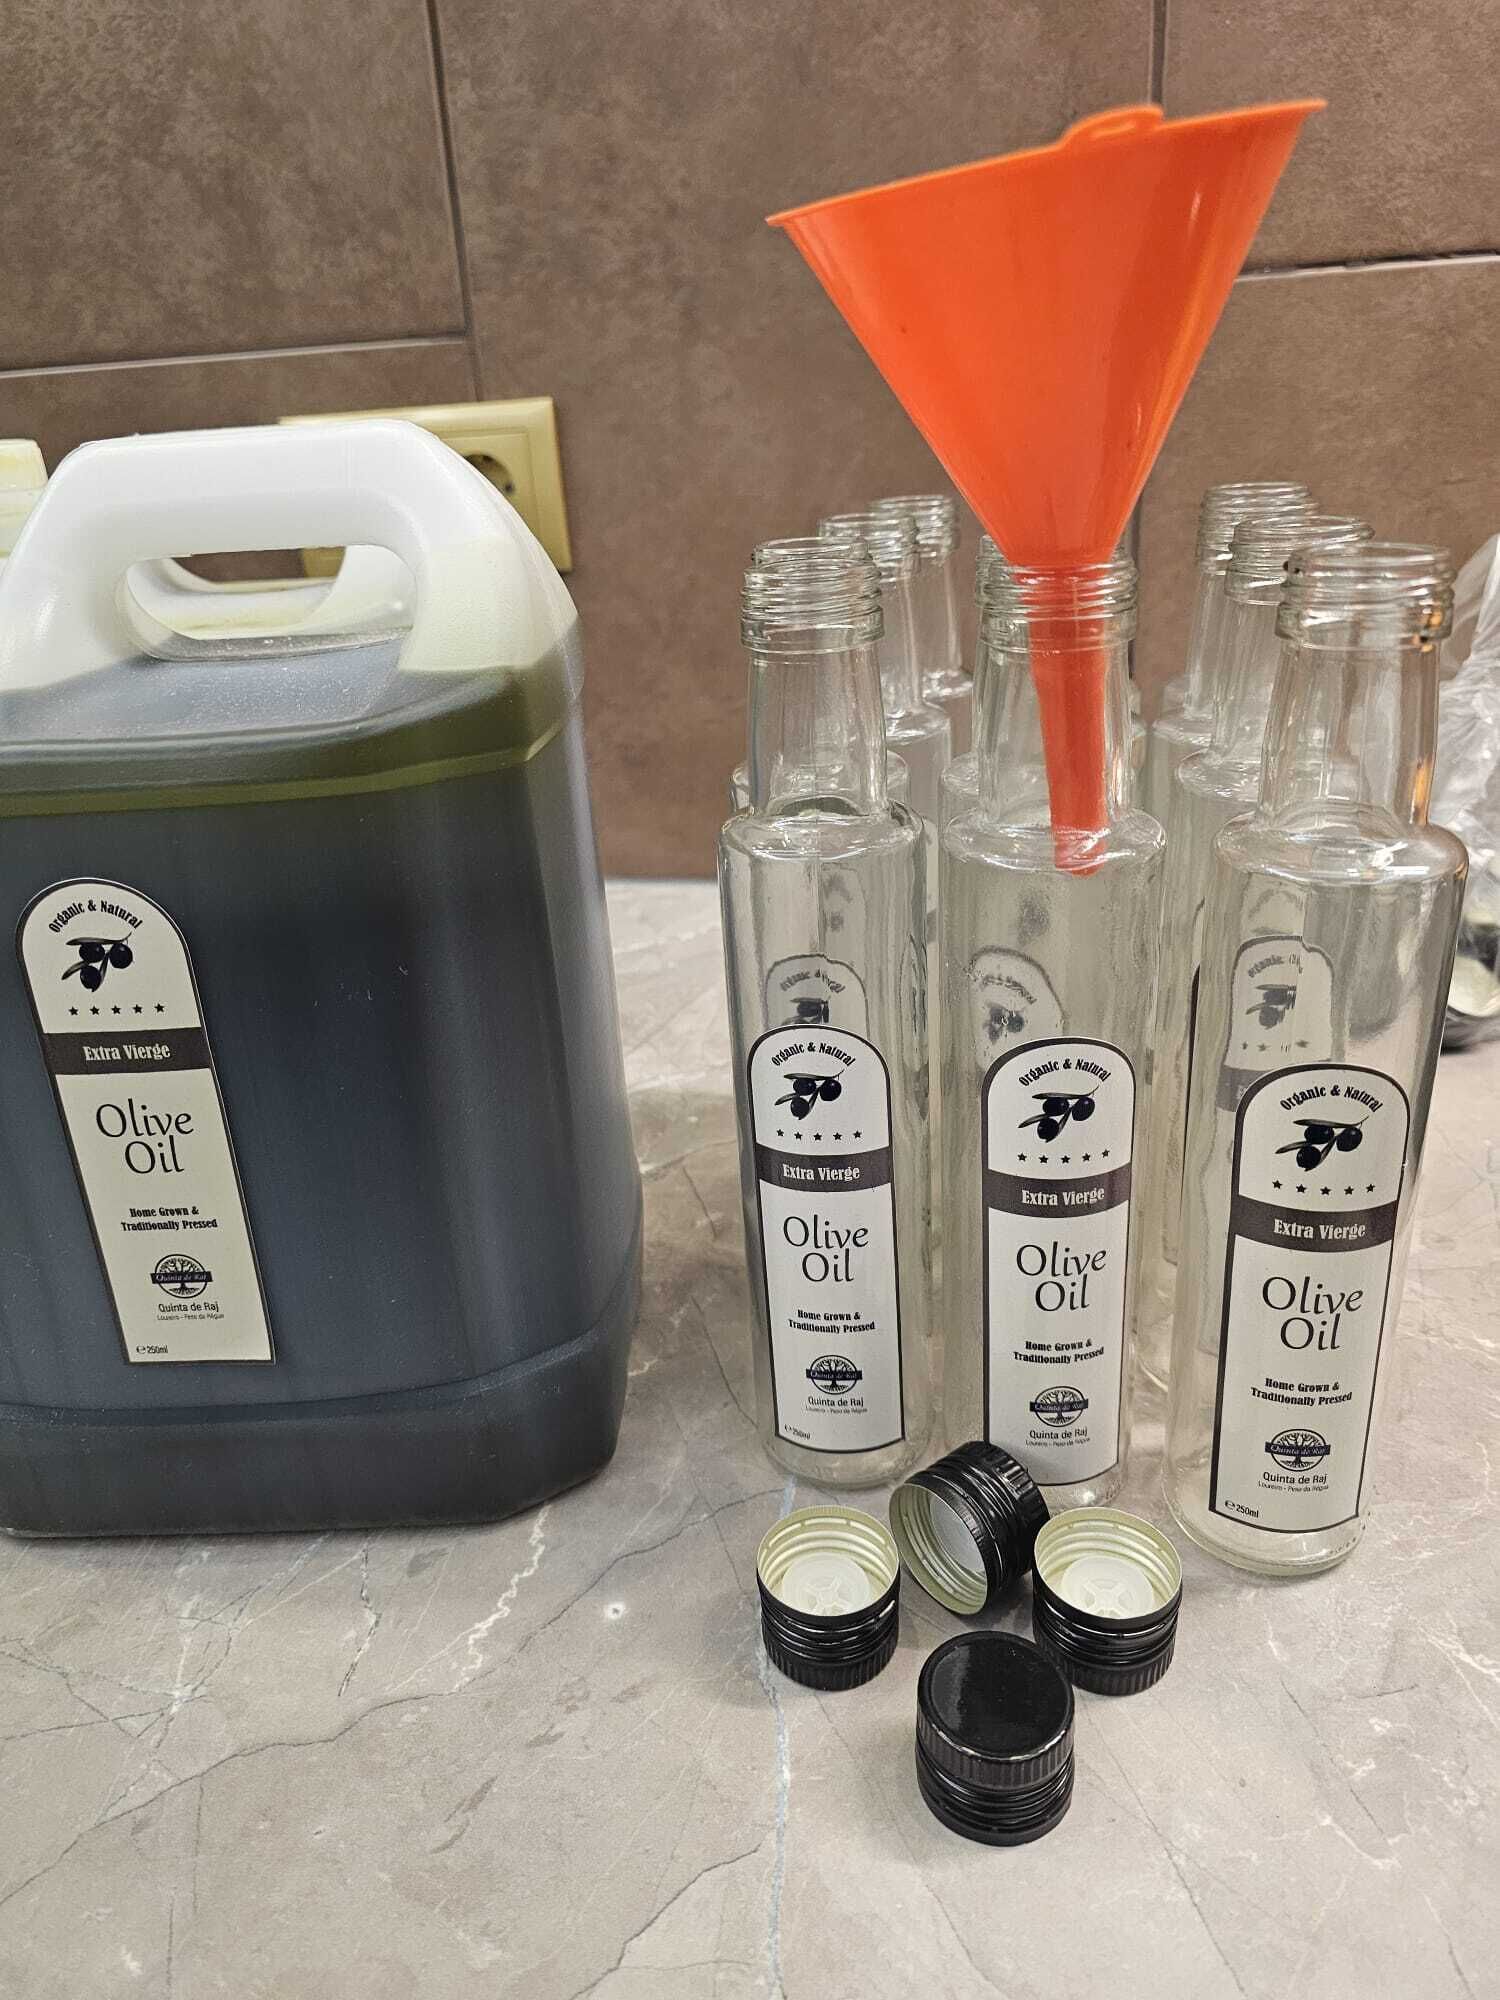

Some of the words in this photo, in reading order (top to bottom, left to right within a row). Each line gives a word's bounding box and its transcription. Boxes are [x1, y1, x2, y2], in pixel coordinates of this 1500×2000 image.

[48, 901, 84, 933] Organic
[88, 900, 97, 912] &
[100, 900, 143, 929] Natural
[83, 1045, 122, 1061] Extra
[123, 1043, 171, 1060] Vierge
[771, 1043, 804, 1067] Organic
[807, 1042, 816, 1052] &
[819, 1043, 856, 1067] Natural
[1018, 1059, 1060, 1087] Organic
[1062, 1058, 1072, 1069] &
[1075, 1058, 1112, 1082] Natural
[1280, 1085, 1326, 1111] Organic
[1330, 1084, 1341, 1097] &
[1344, 1086, 1384, 1113] Natural
[96, 1098, 194, 1138] Olive
[124, 1135, 184, 1174] Oil
[782, 1163, 815, 1181] Extra
[817, 1166, 861, 1181] Vierge
[1021, 1189, 1058, 1206] Extra
[1061, 1187, 1105, 1205] Vierge
[129, 1208, 156, 1218] Home
[158, 1207, 189, 1216] Grown
[191, 1206, 200, 1215] &
[121, 1220, 180, 1232] Traditionally
[182, 1219, 218, 1229] Pressed
[783, 1214, 869, 1249] Olive
[1273, 1218, 1314, 1239] Extra
[1319, 1223, 1366, 1240] Vierge
[802, 1248, 854, 1282] Oil
[1016, 1241, 1107, 1277] Olive
[1035, 1273, 1090, 1312] Oil
[1262, 1276, 1364, 1315] Olive
[158, 1303, 188, 1313] Quinta
[190, 1302, 202, 1312] de
[204, 1301, 219, 1312] Raj
[797, 1309, 821, 1320] Home
[823, 1312, 851, 1321] Grown
[853, 1312, 861, 1320] &
[788, 1319, 840, 1334] Traditionally
[843, 1321, 875, 1333] Pressed
[1280, 1312, 1341, 1351] Oil
[1025, 1340, 1052, 1351] Home
[1054, 1341, 1083, 1351] Grown
[1085, 1338, 1092, 1347] &
[1013, 1351, 1072, 1364] Traditionally
[1074, 1347, 1104, 1363] Pressed
[1265, 1377, 1295, 1391] Home
[1298, 1382, 1330, 1392] Grown
[1332, 1381, 1340, 1391] &
[808, 1396, 835, 1406] Quinta
[837, 1398, 848, 1406] de
[851, 1397, 864, 1407] Raj
[1251, 1387, 1316, 1407] Traditionally
[1318, 1391, 1353, 1406] Pressed
[1029, 1429, 1059, 1440] Quinta
[1061, 1430, 1072, 1439] de
[1074, 1426, 1088, 1437] Raj
[1263, 1471, 1295, 1484] Quinta
[1298, 1476, 1310, 1484] de
[1313, 1473, 1328, 1484] Raj
[1236, 1504, 1259, 1518] 250ml
